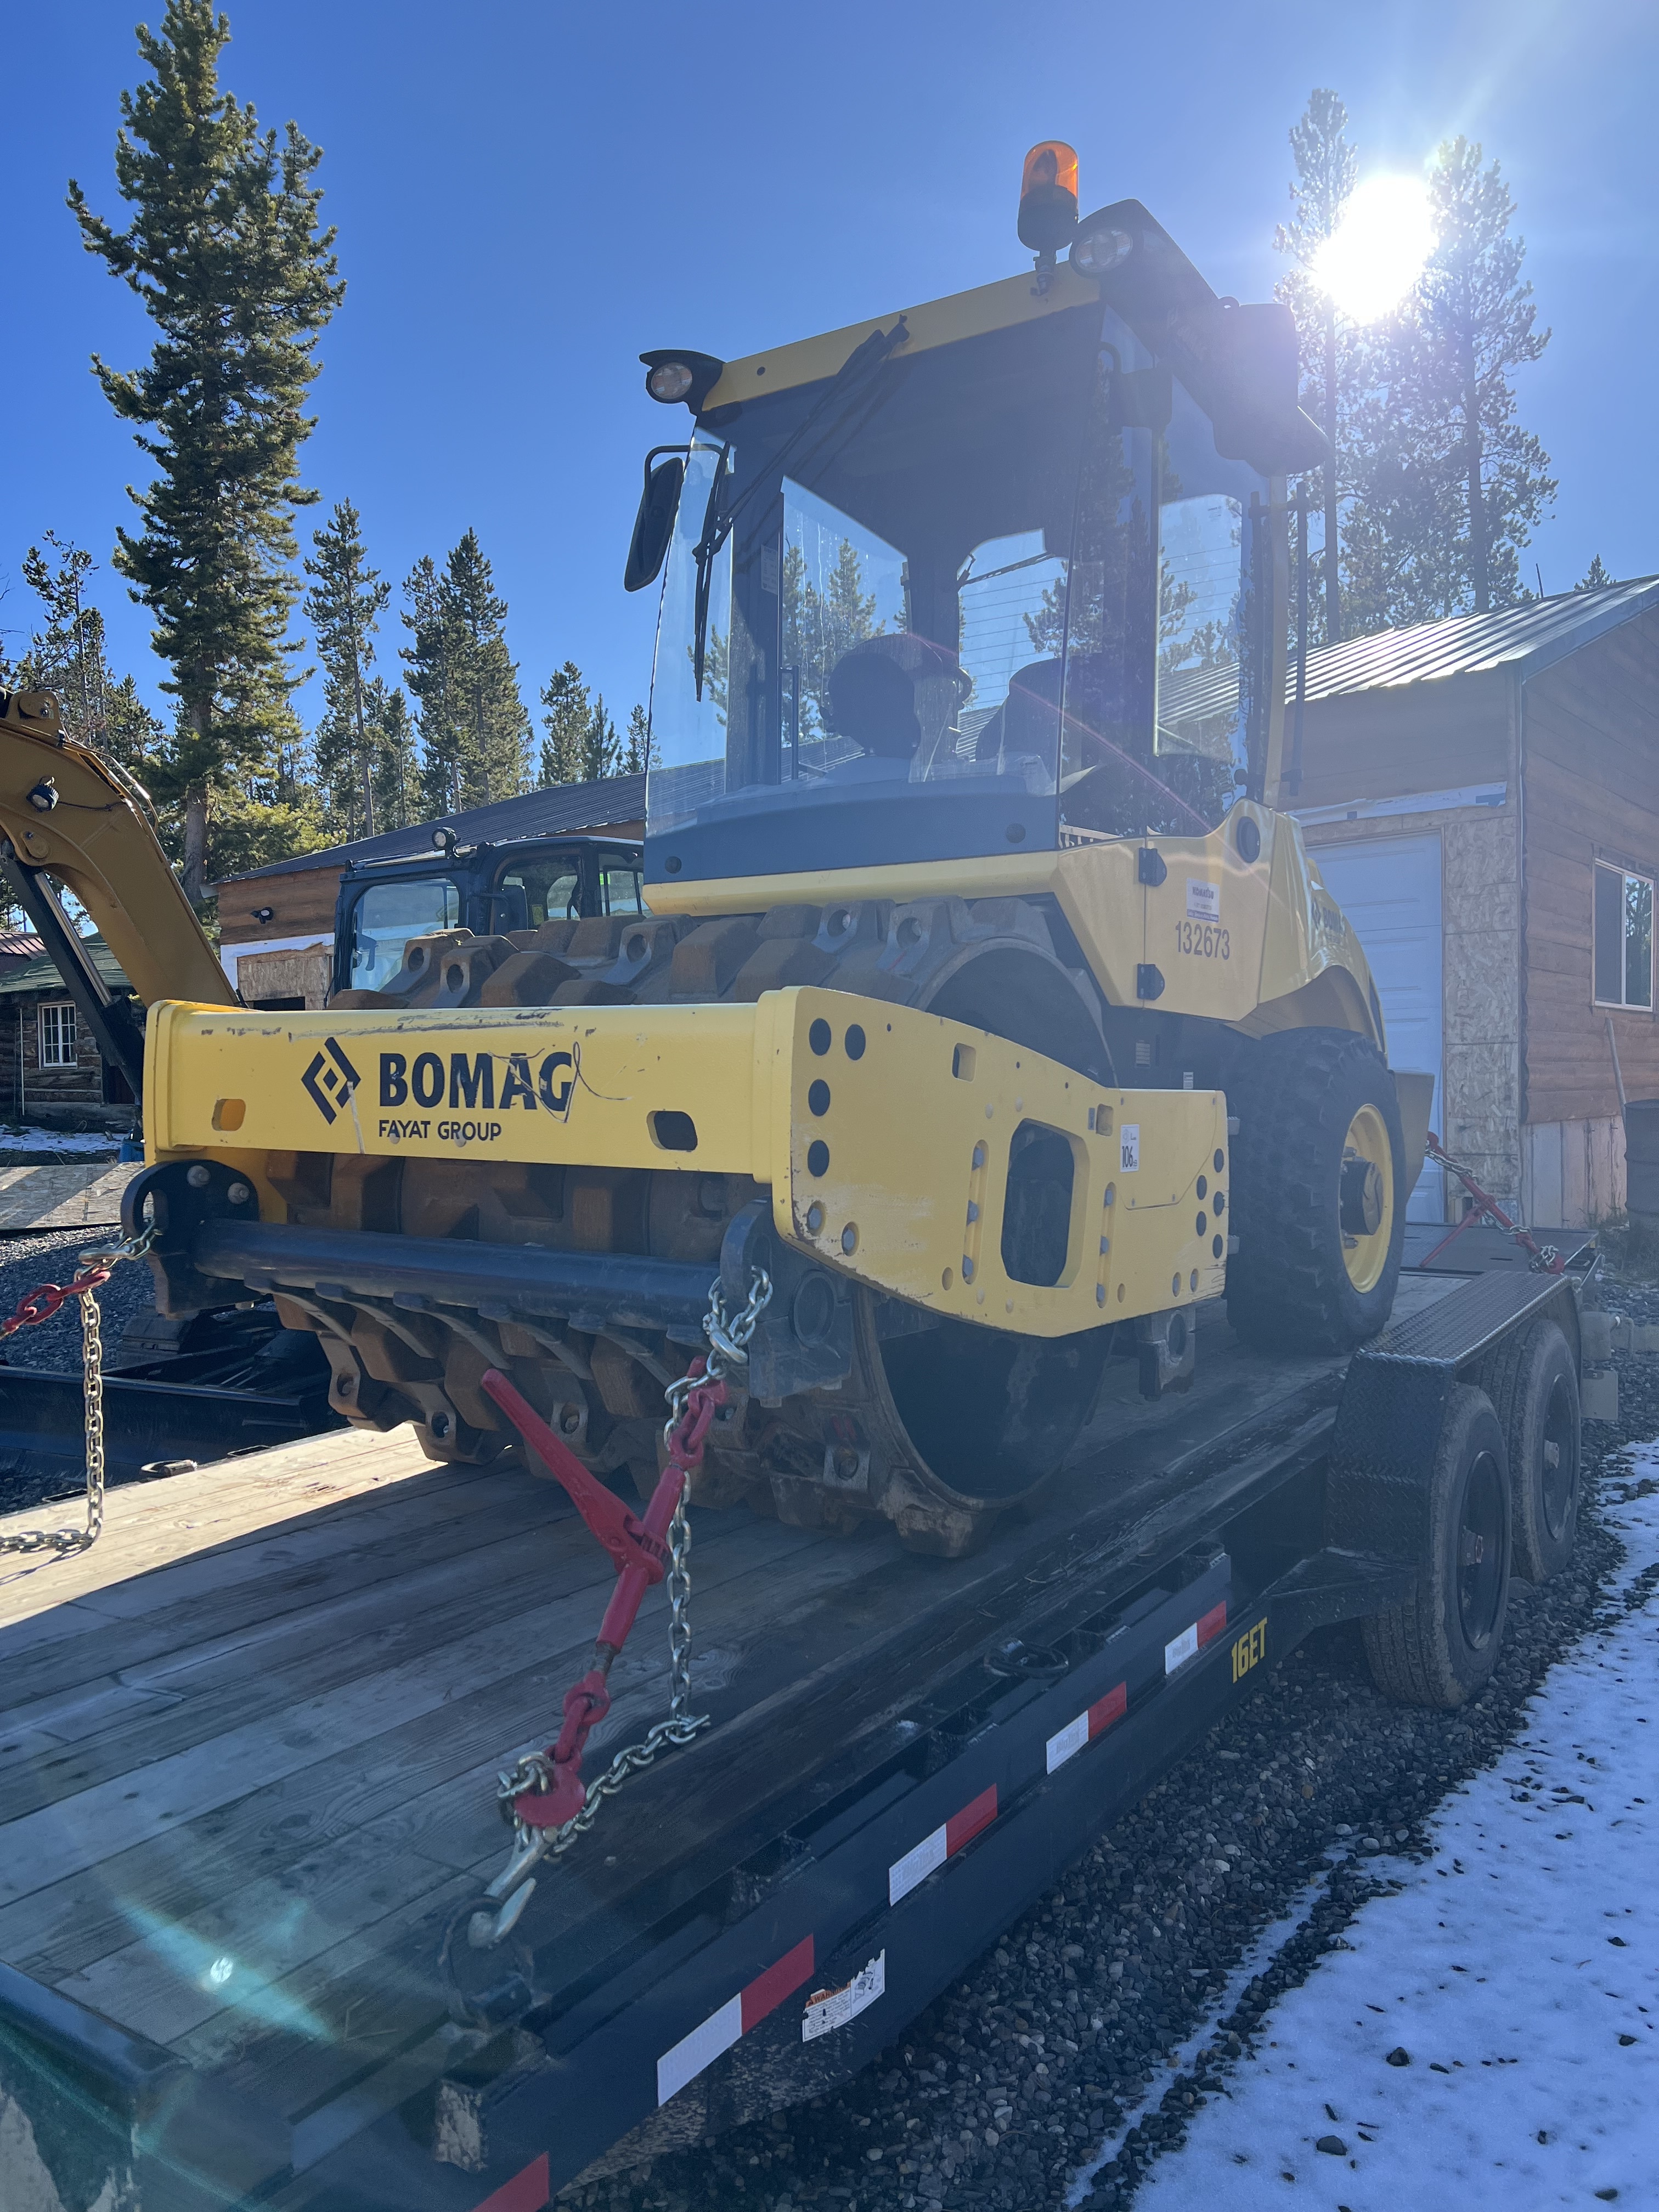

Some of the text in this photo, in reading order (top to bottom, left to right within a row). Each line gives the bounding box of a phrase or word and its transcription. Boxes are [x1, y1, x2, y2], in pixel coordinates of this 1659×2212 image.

[1192, 886, 1214, 900] KOMATSU
[1175, 921, 1230, 961] 132673
[380, 1052, 572, 1111] BOMAG
[379, 1120, 502, 1141] FAYAT GROUP
[1121, 1145, 1133, 1168] 106
[1231, 1616, 1268, 1684] 16ET
